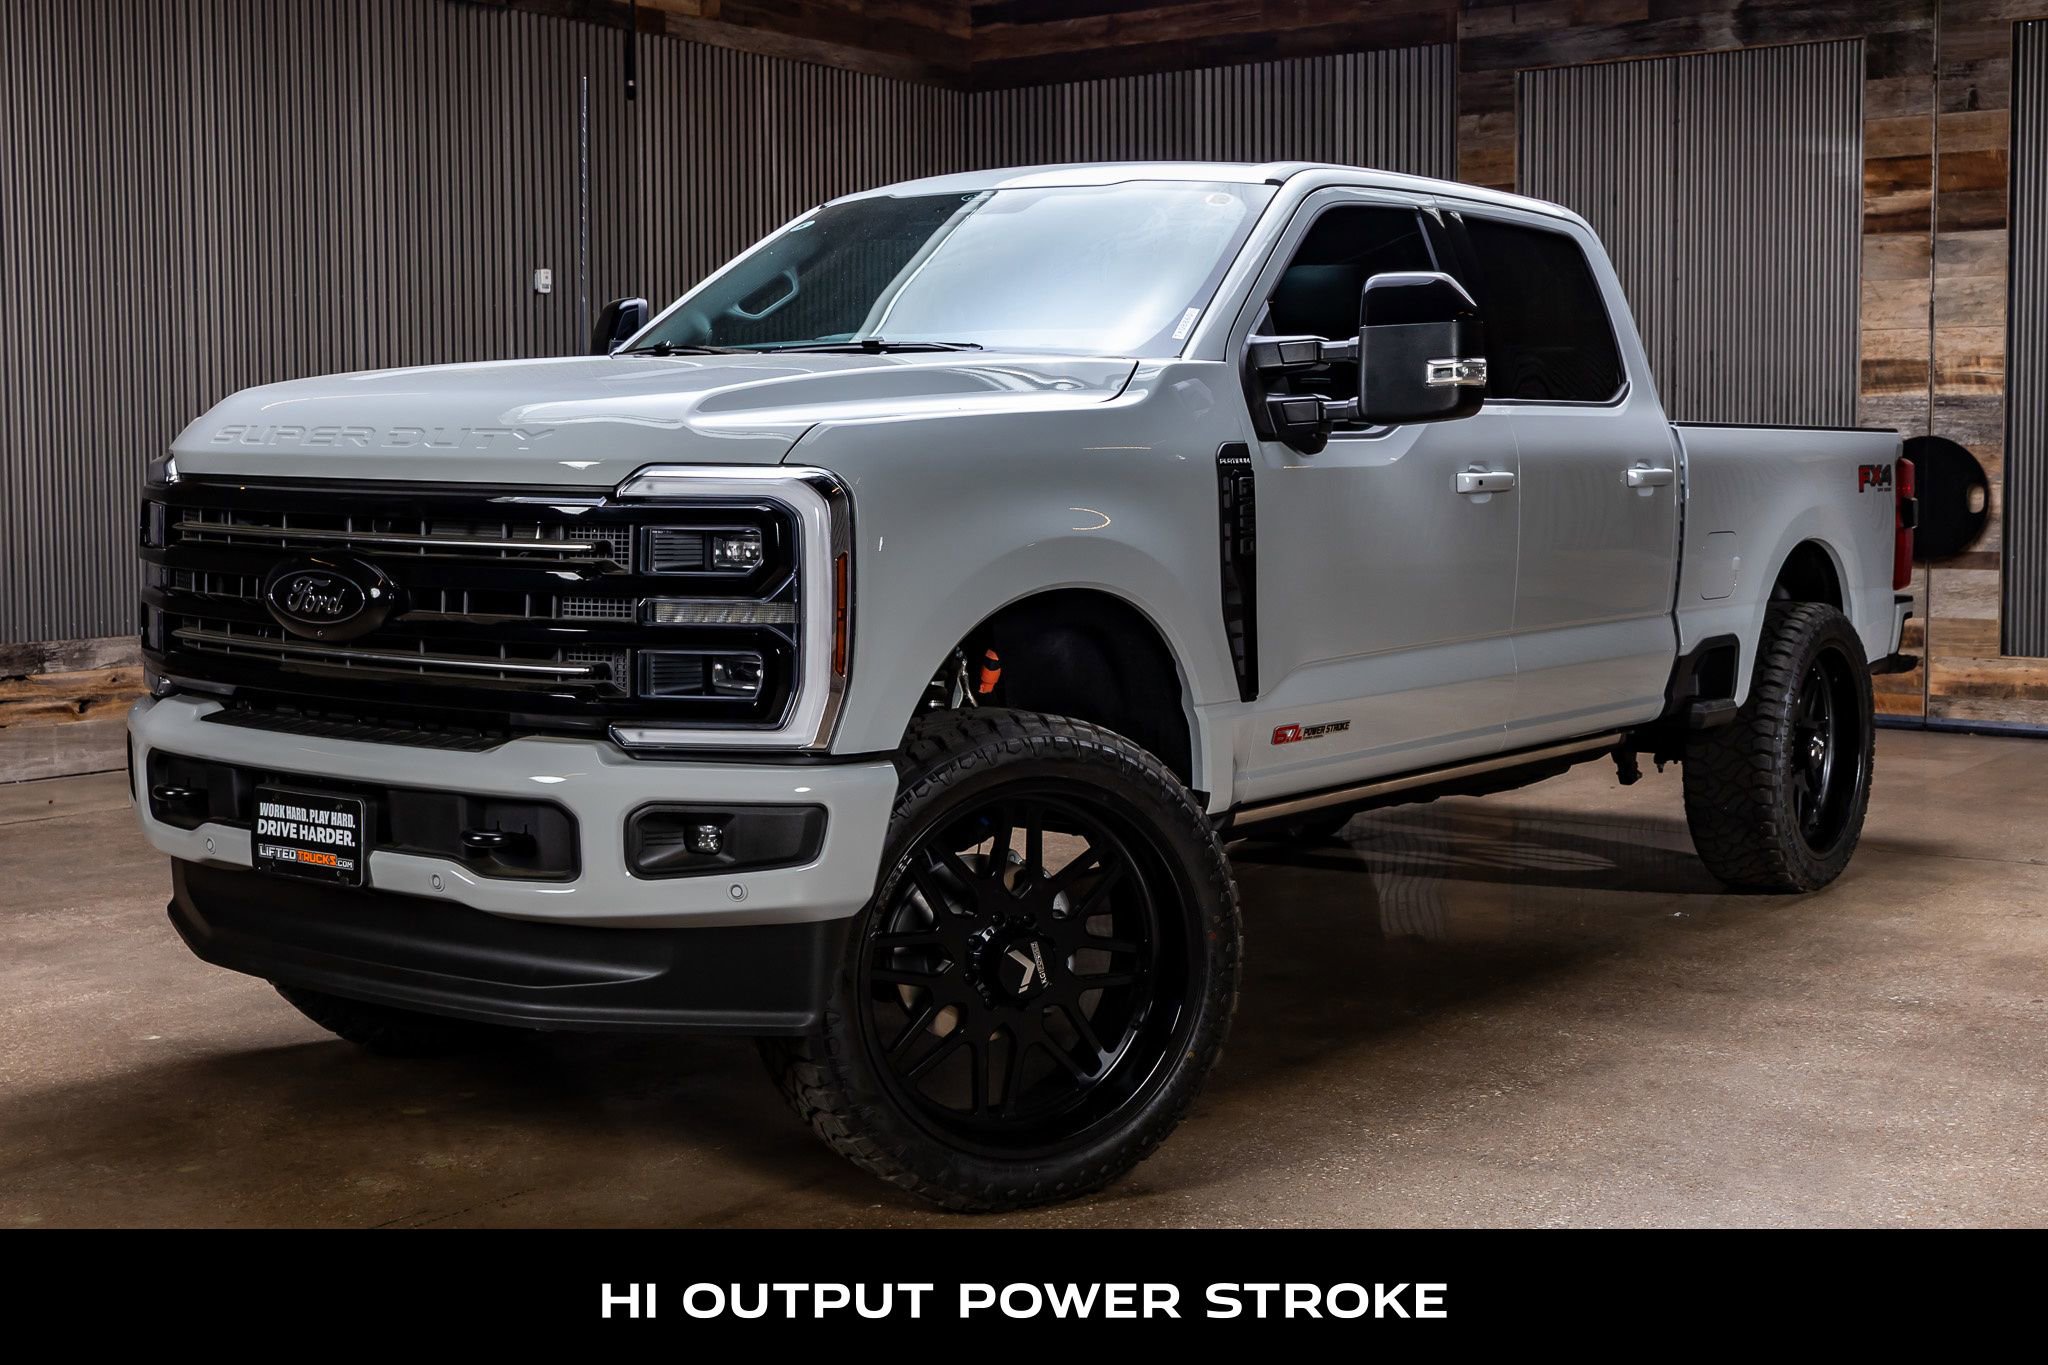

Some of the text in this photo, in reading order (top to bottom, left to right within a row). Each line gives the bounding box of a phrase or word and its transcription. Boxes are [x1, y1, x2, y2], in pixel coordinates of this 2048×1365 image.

[209, 424, 556, 450] SUPER DUTY
[1858, 464, 1892, 493] FX4
[287, 576, 346, 614] Ford
[1303, 725, 1326, 737] POWER
[1325, 721, 1351, 733] STROKE
[259, 802, 356, 829] WORK HARD. PLAY HARD.
[257, 818, 356, 847] DRIVE HARDER.
